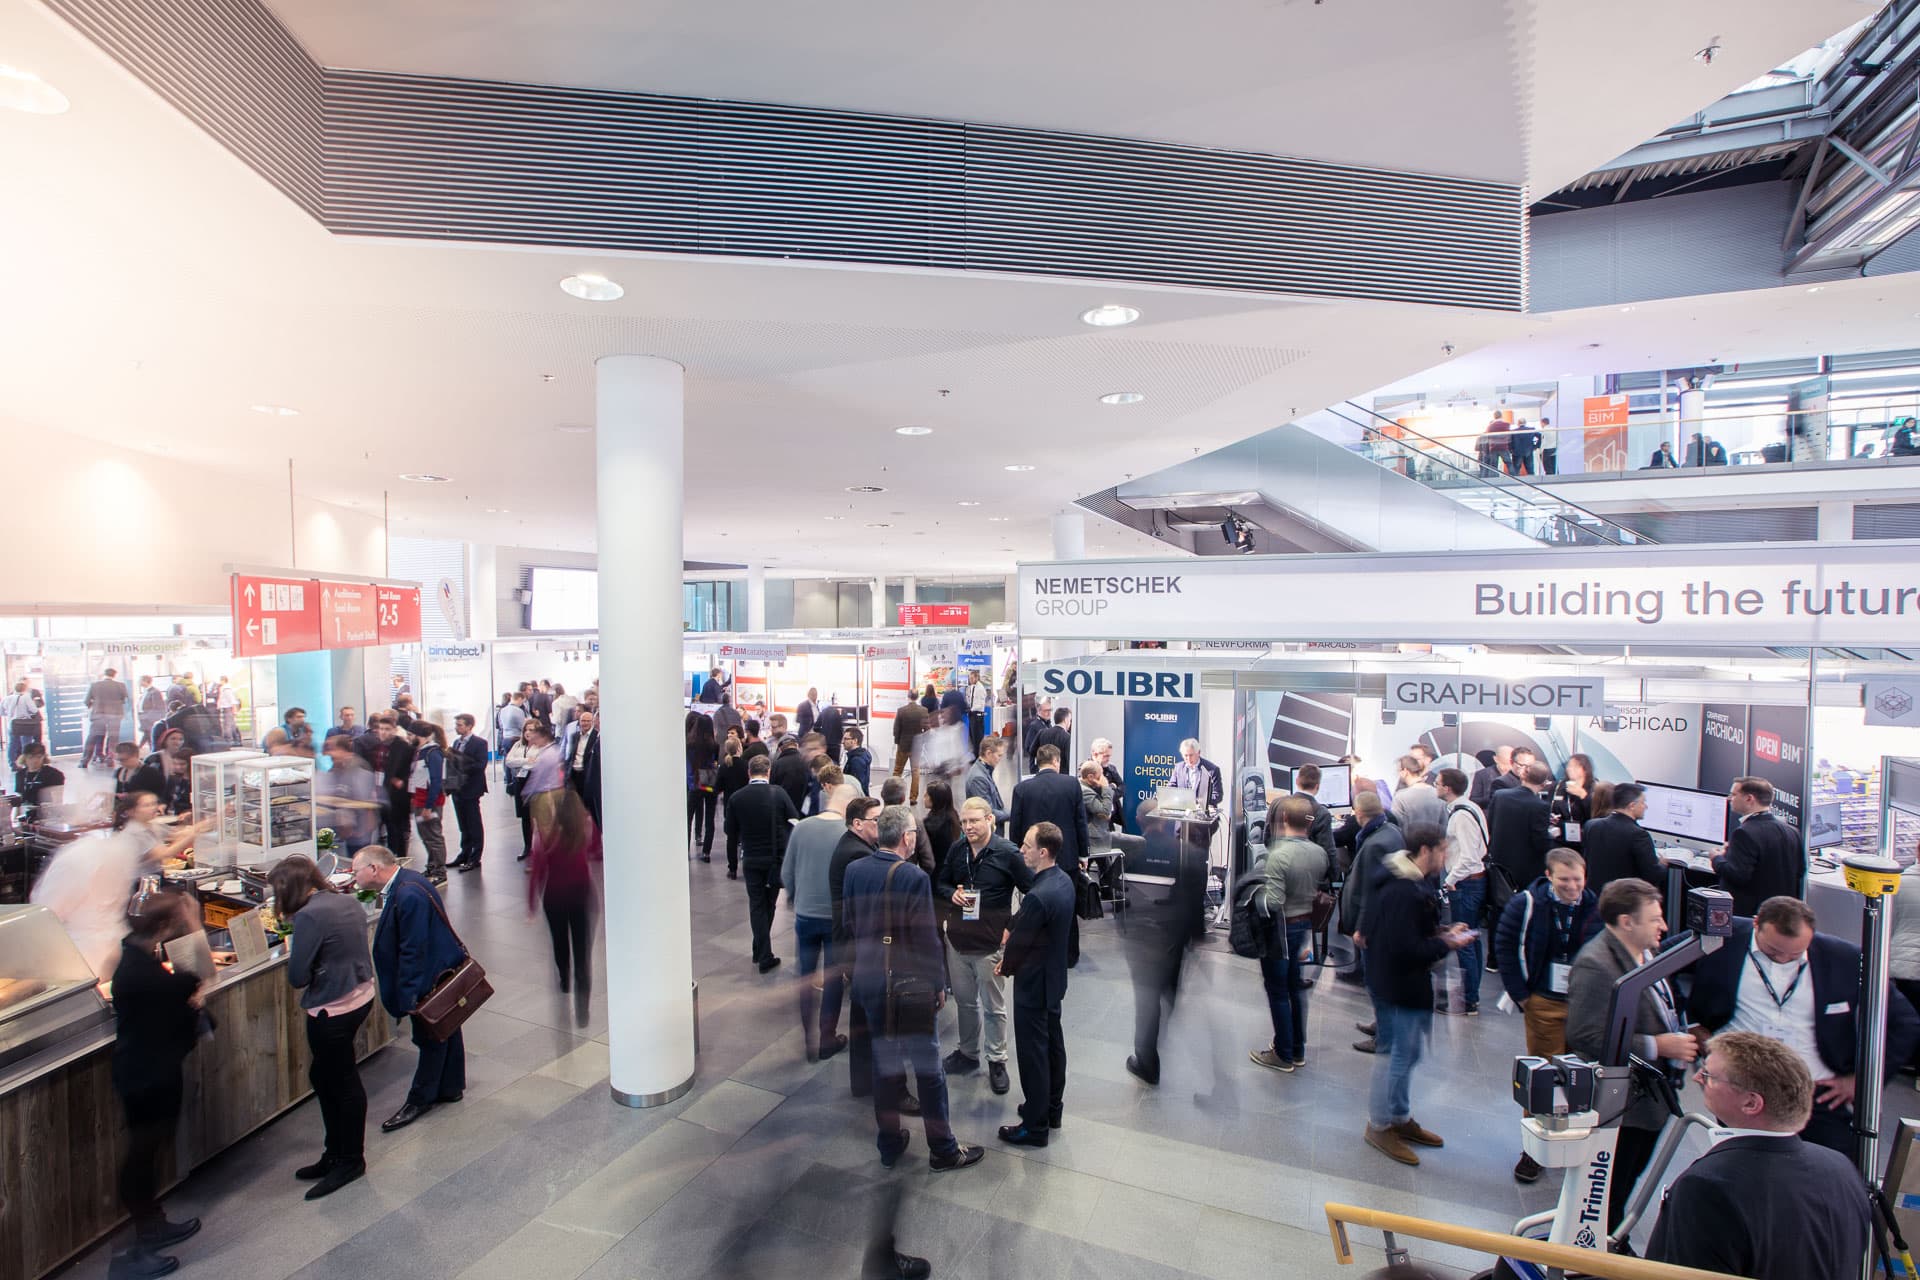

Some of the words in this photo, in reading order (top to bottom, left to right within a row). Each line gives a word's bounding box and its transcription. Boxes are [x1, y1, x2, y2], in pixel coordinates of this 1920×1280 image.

[1589, 412, 1615, 424] BIM
[1035, 576, 1182, 595] NEMETSCHEK
[1035, 599, 1108, 617] GROUP
[1475, 582, 1664, 624] Building
[1682, 581, 1764, 616] the
[380, 603, 399, 626] 2-5
[335, 616, 341, 643] 1
[429, 644, 480, 658] bimobject
[734, 647, 785, 658] BIMcatalogs.net
[972, 639, 991, 649] TOPCON
[1205, 641, 1270, 649] NEWFORMA
[1318, 641, 1356, 649] ARCADIS
[1043, 668, 1194, 699] SOLIBRI
[1396, 681, 1593, 708] GRAPHISOFT
[1144, 713, 1178, 722] SOLIBRI
[1589, 715, 1688, 732] ACHICAD
[1705, 720, 1744, 745] ARCHICAD
[1756, 735, 1778, 758] OPEN
[1144, 755, 1177, 765] MODEL
[1579, 1150, 1611, 1224] Trimble
